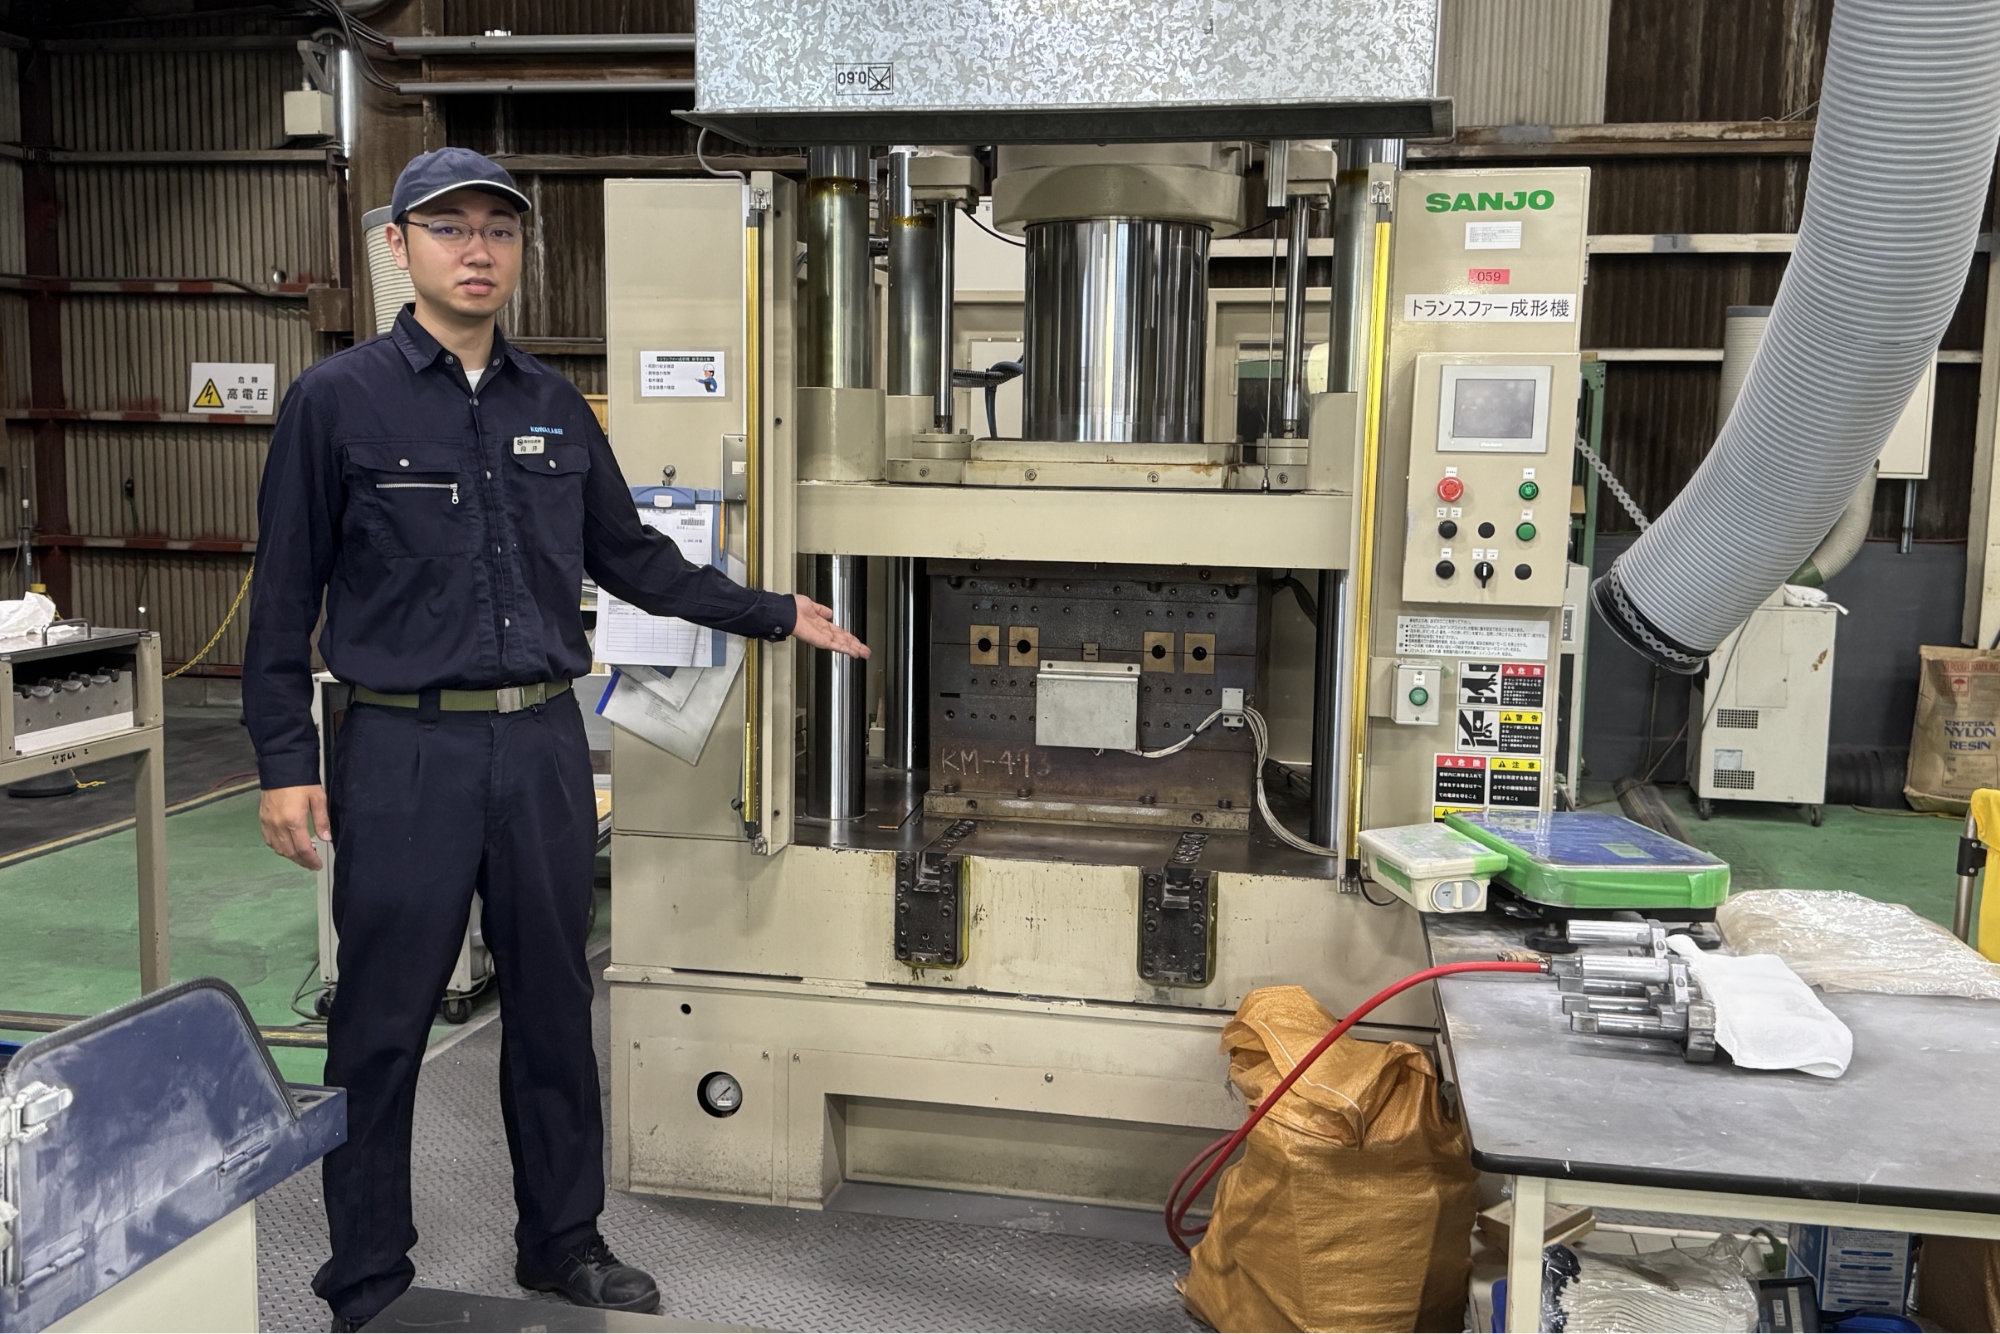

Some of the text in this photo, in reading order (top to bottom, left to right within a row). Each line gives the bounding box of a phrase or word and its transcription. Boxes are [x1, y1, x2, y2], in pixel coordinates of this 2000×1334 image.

[1425, 189, 1555, 213] SANJO
[1477, 271, 1501, 282] 059
[1412, 299, 1570, 317] トランスファー成形機
[227, 388, 268, 400] 高電圧
[1517, 667, 1541, 675] 危険
[1515, 713, 1539, 722] 警告
[1944, 727, 1996, 738] NYLON
[1949, 740, 1991, 750] RESIN
[1457, 758, 1481, 767] 危険
[1512, 761, 1535, 769] 注意
